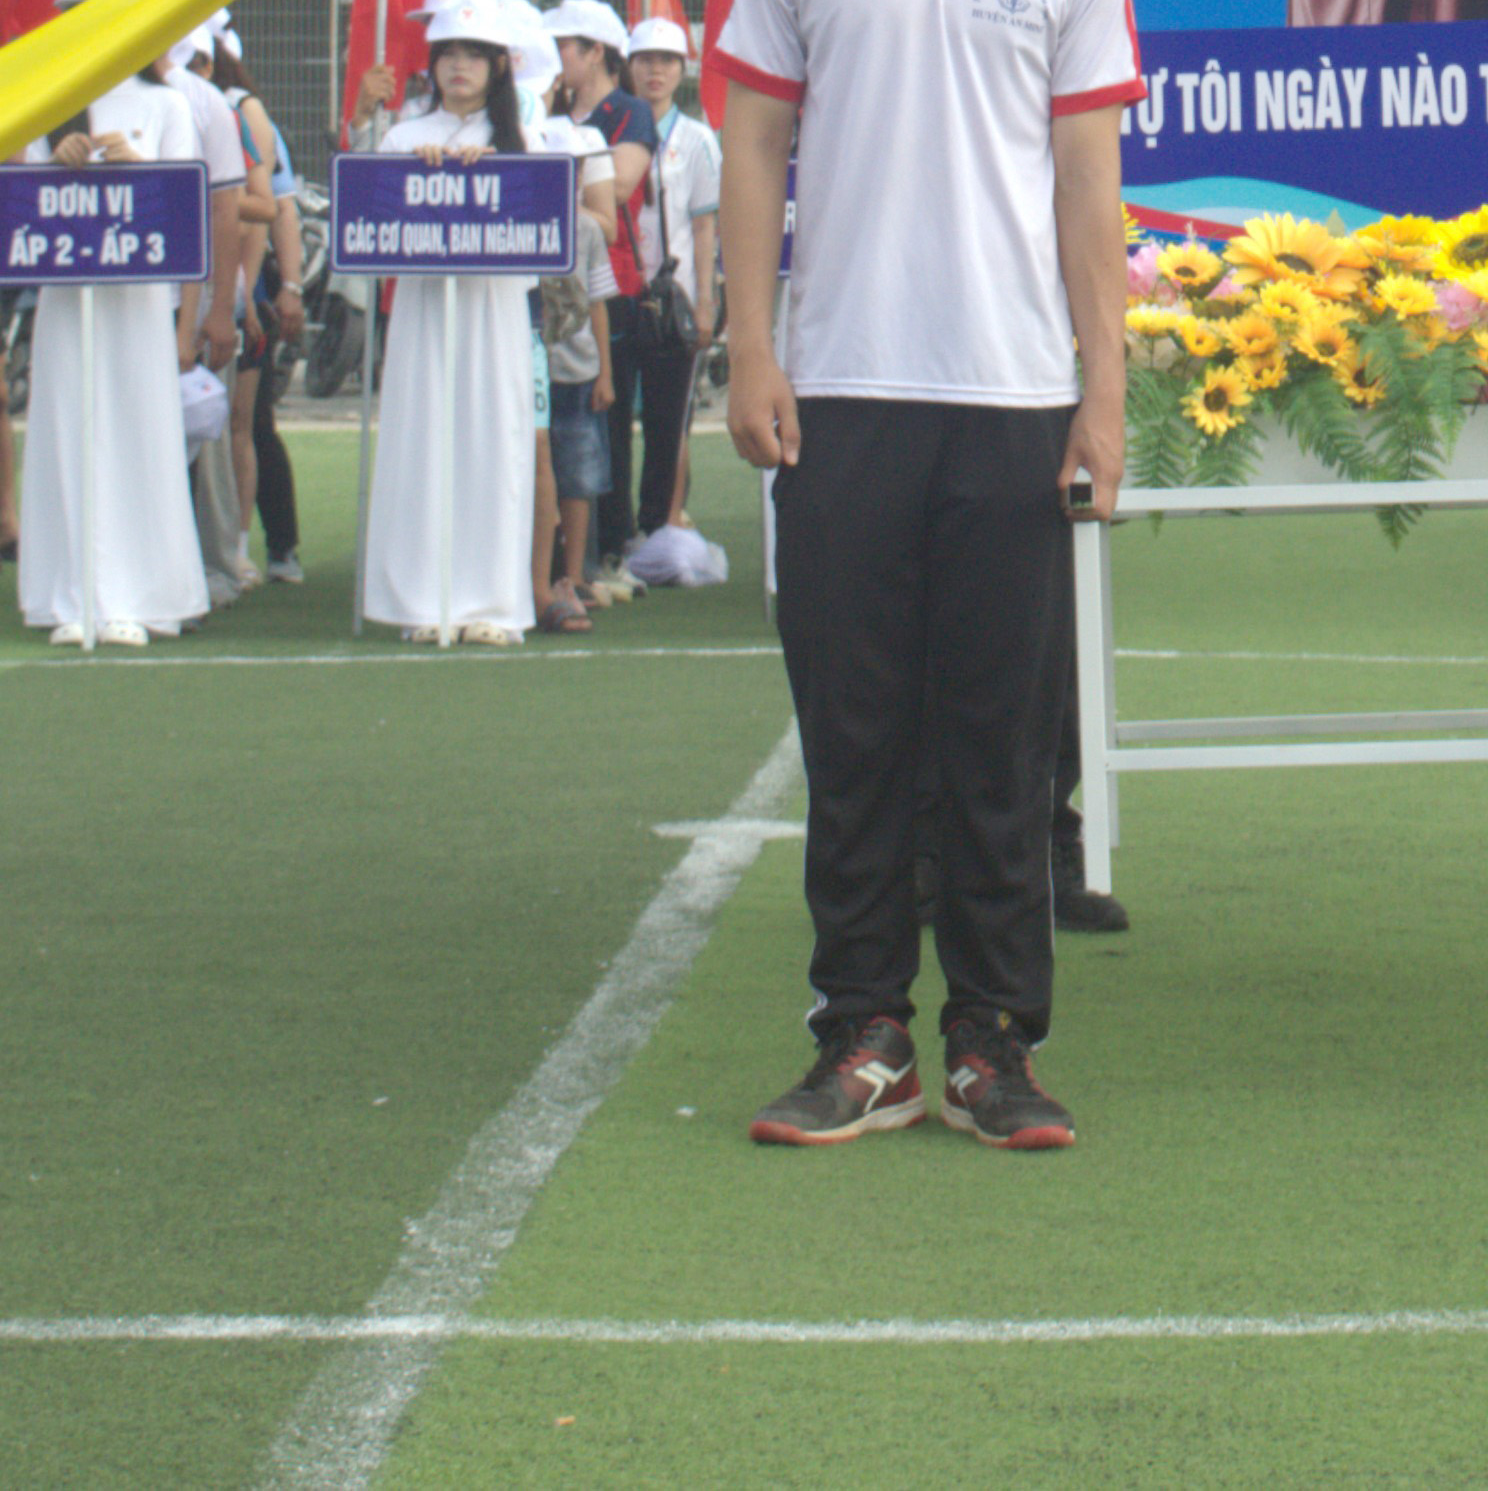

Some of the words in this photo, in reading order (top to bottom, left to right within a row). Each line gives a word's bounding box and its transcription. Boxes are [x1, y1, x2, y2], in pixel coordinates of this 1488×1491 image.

[1175, 58, 1242, 134] TÔI
[1254, 55, 1368, 131] NGÀY
[1380, 52, 1469, 128] NÀO
[38, 182, 99, 218] ĐƠN
[105, 184, 134, 222] VỊ
[404, 171, 466, 206] ĐƠN
[472, 174, 501, 213] VỊ
[8, 223, 48, 267] ẤP
[54, 233, 75, 266] 2
[99, 222, 140, 266] ẤP
[146, 232, 165, 265] 3
[344, 216, 376, 254] CÁC
[378, 219, 401, 254] CƠ
[402, 222, 447, 257] QUAN,
[449, 222, 482, 254] BAN
[484, 216, 538, 254] NGÀNH
[539, 217, 562, 254] XÃ
